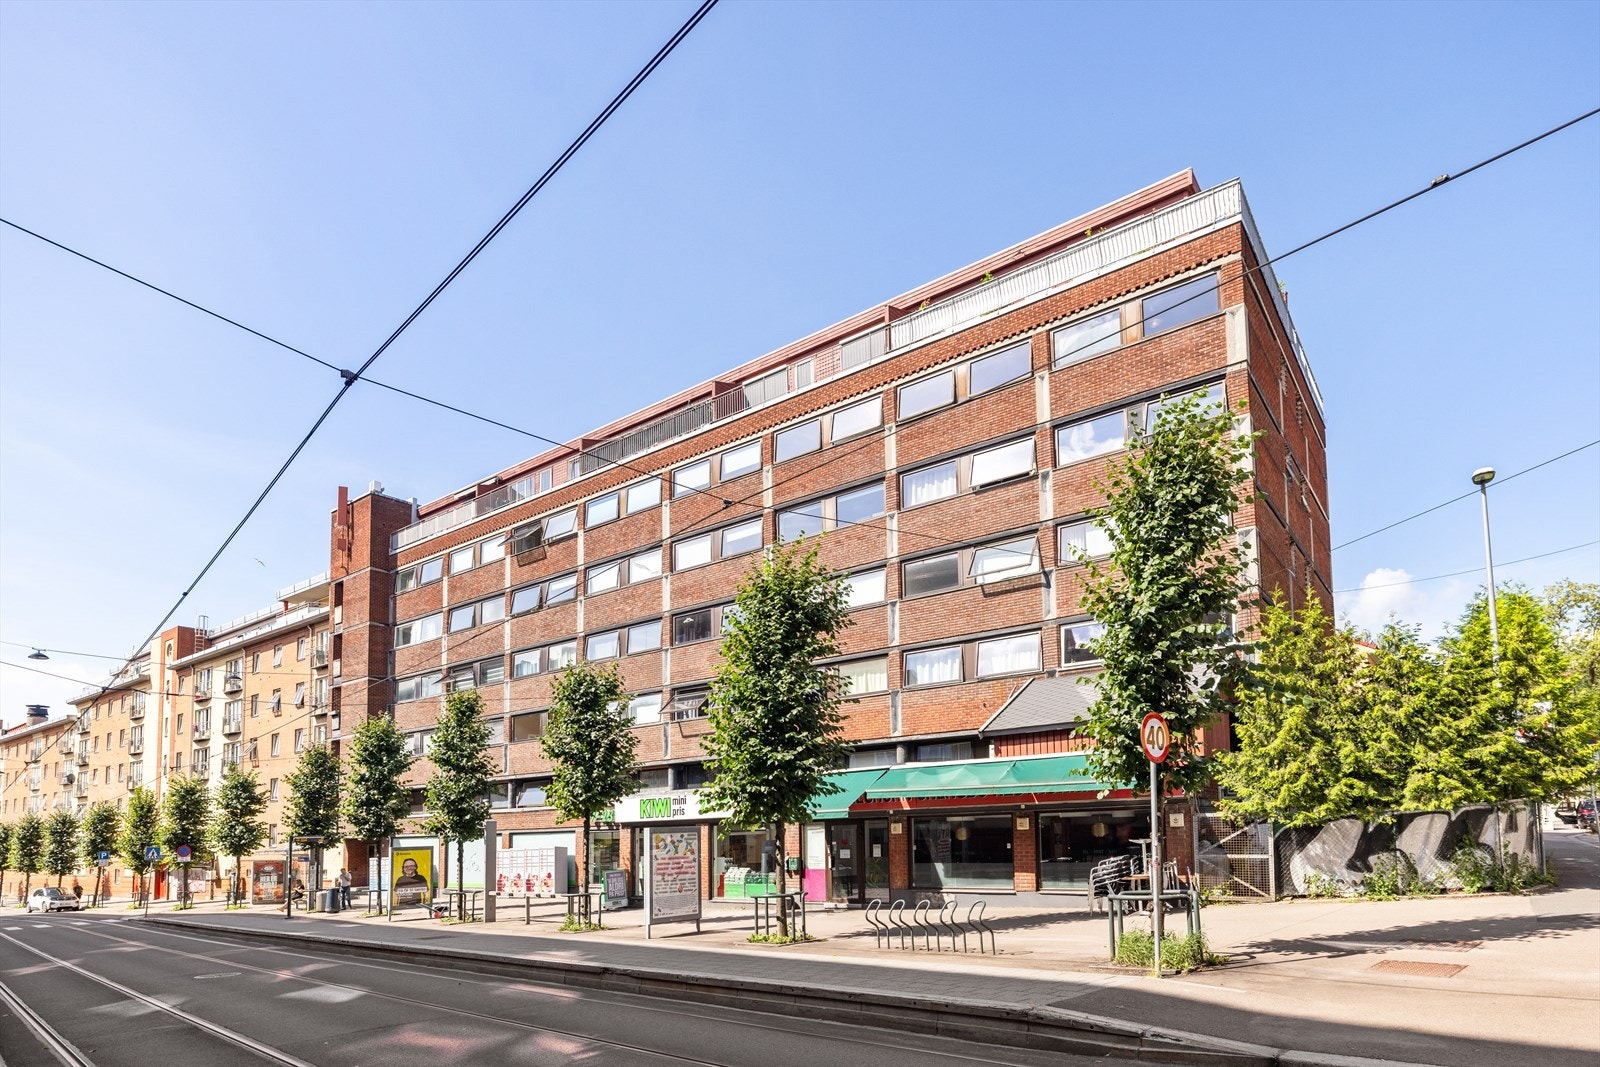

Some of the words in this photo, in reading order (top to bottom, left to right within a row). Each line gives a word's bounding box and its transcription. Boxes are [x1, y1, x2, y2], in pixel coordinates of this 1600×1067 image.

[1147, 725, 1165, 751] 40
[640, 797, 671, 819] KIWI
[672, 795, 687, 805] mini
[672, 807, 685, 818] pris
